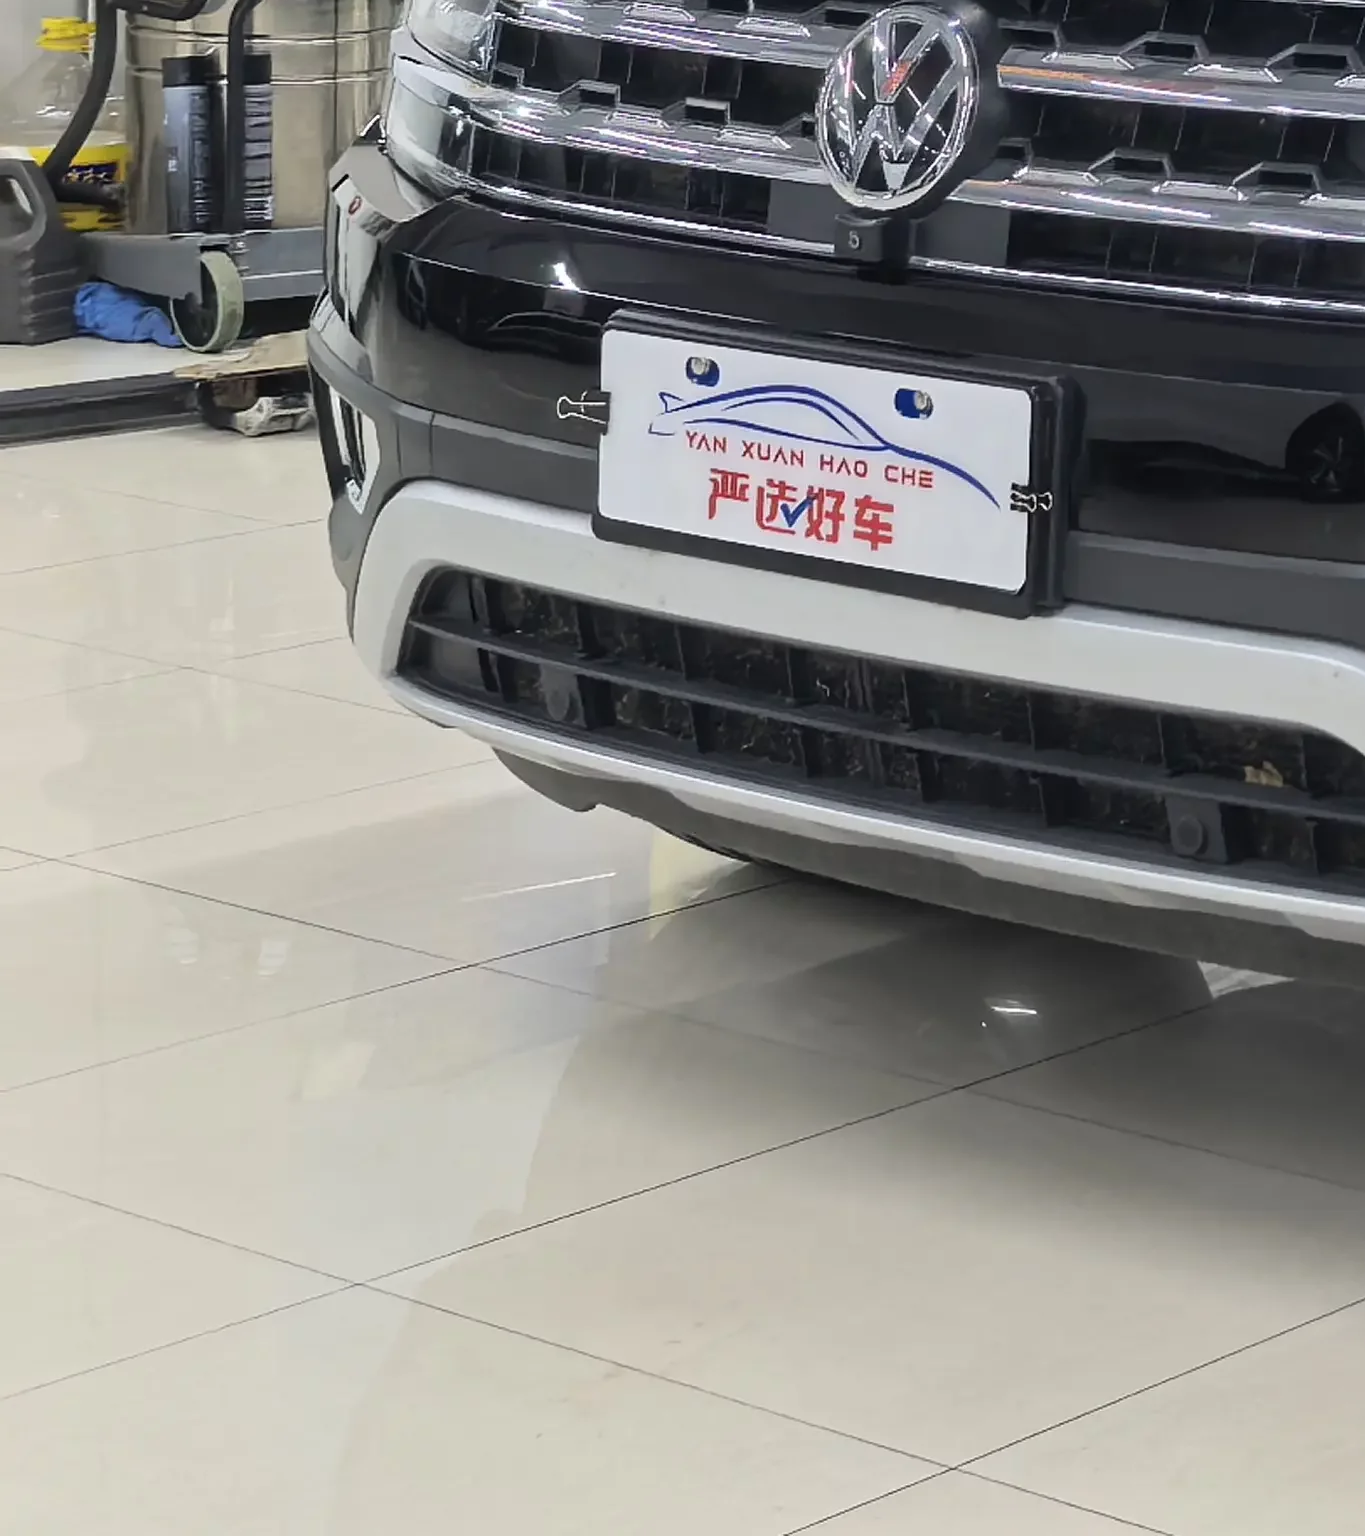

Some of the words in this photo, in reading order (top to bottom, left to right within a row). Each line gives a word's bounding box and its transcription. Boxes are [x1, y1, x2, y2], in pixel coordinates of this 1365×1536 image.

[685, 430, 728, 455] YAN
[741, 440, 805, 468] XUAN
[819, 453, 869, 479] HAO
[884, 465, 935, 490] CHE
[708, 467, 895, 552] 严选好车
